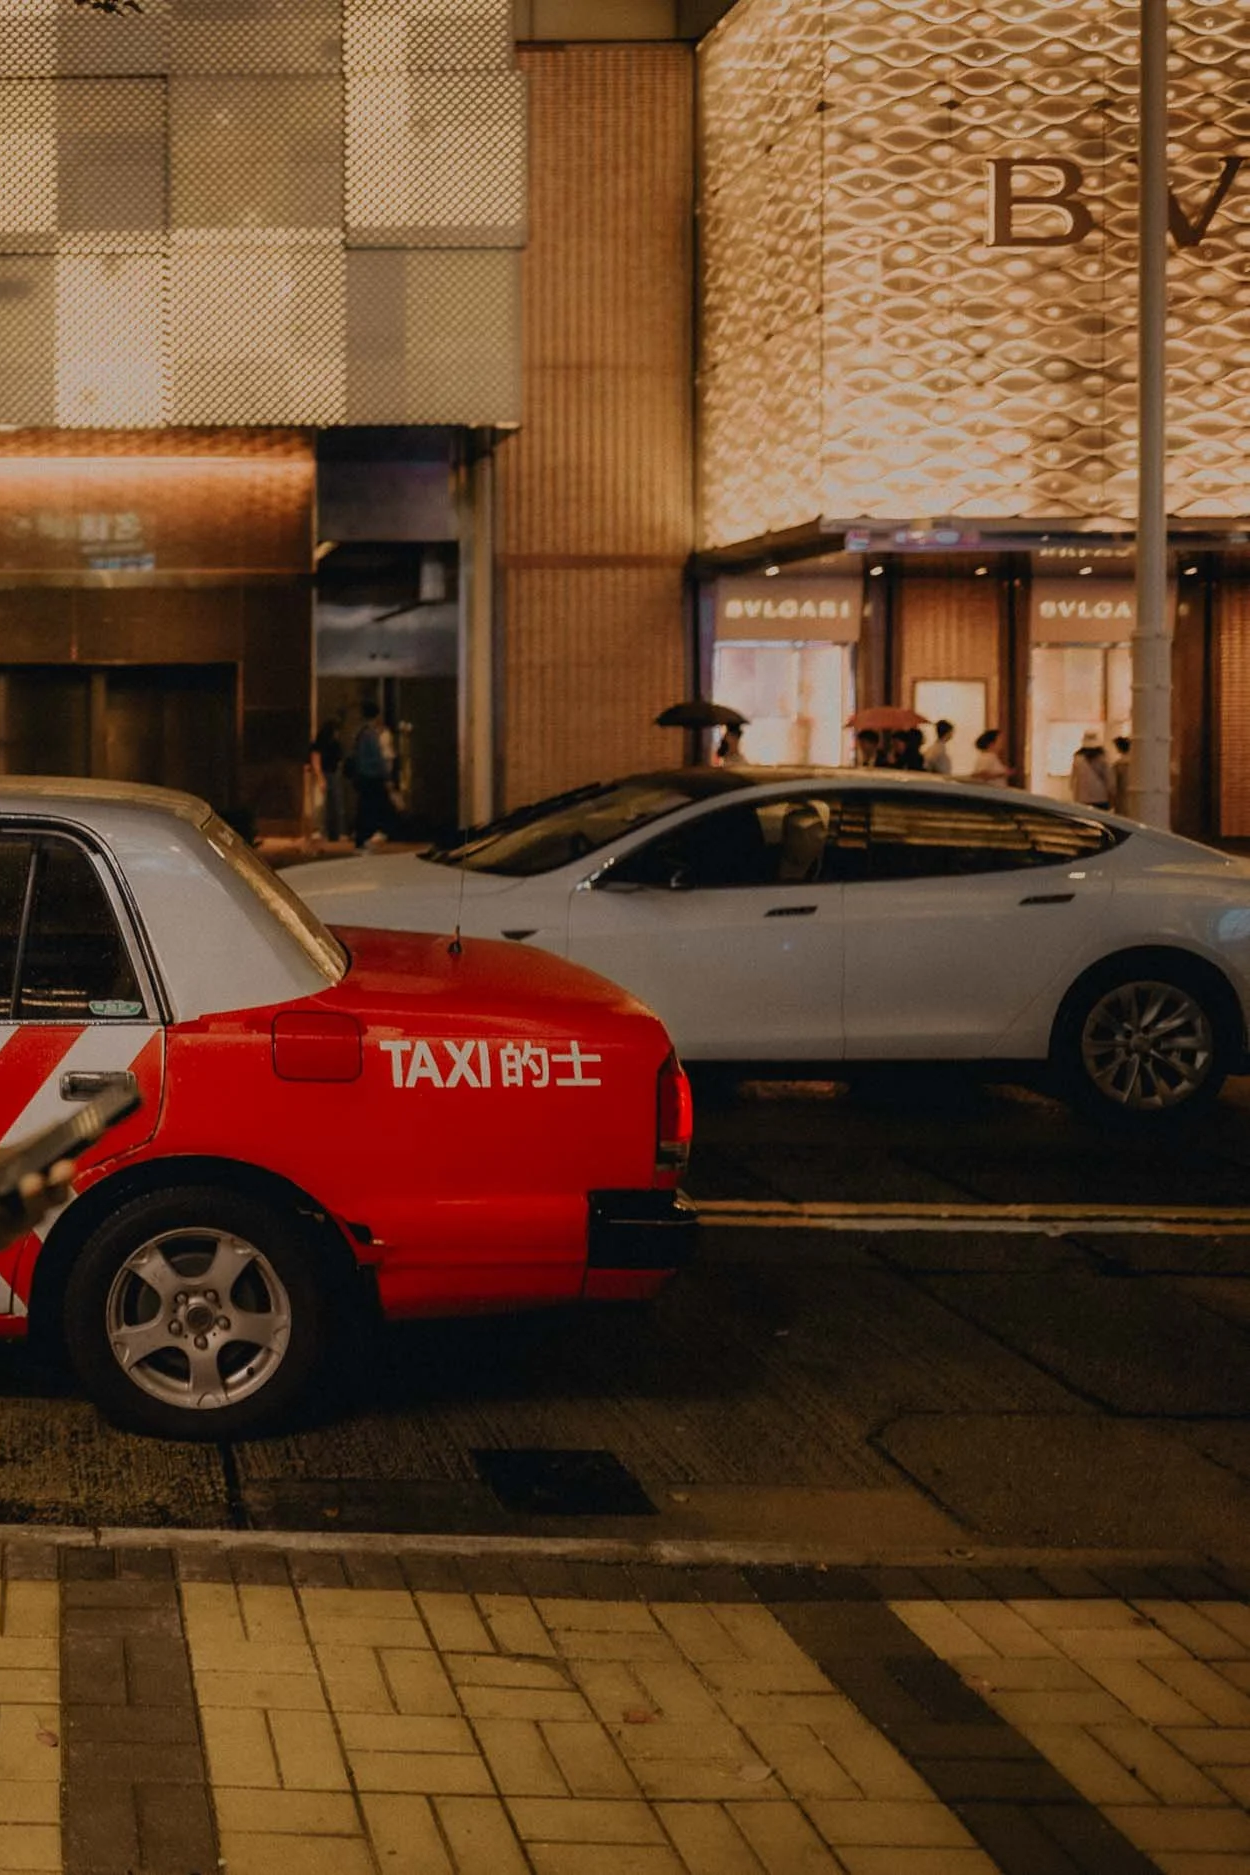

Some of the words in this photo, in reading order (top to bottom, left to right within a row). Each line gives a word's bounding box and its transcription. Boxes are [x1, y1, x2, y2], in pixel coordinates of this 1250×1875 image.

[725, 600, 849, 618] BVLGARI
[1039, 601, 1132, 618] BVLGA
[379, 1040, 491, 1088] TAXI
[500, 1040, 602, 1088] 的士
